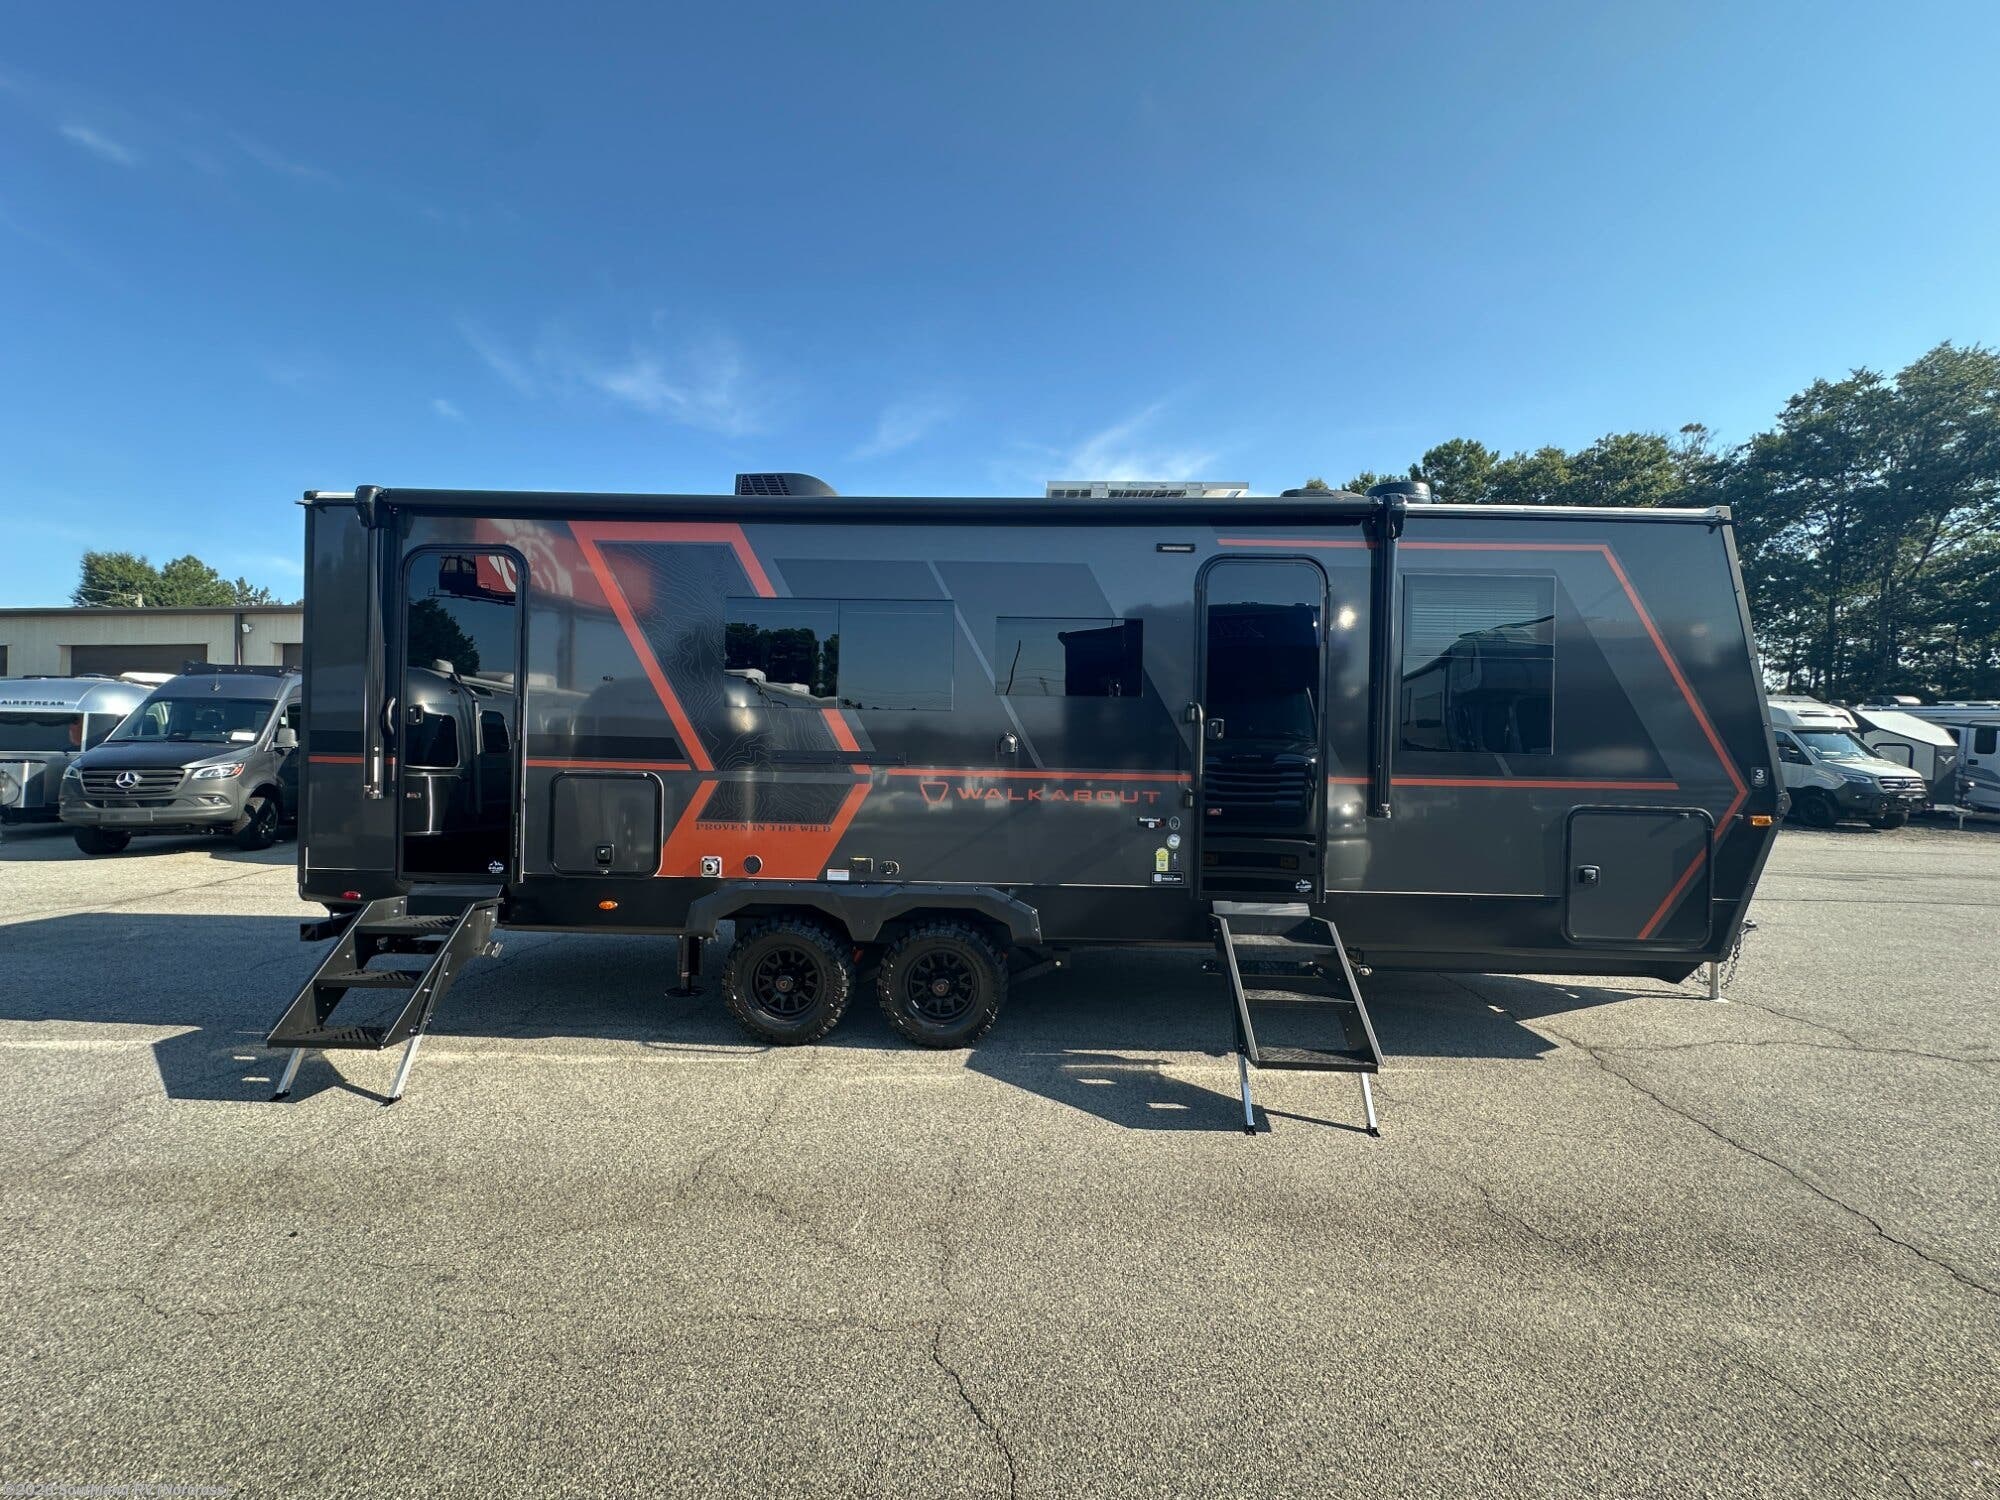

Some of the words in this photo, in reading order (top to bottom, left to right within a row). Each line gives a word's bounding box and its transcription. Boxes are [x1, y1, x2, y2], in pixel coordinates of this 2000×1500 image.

[1755, 769, 1764, 779] 3
[957, 787, 1161, 803] WALKABOUT
[696, 822, 749, 831] PROVEN
[752, 824, 766, 832] IN
[769, 824, 796, 832] THE
[800, 824, 832, 832] WILD
